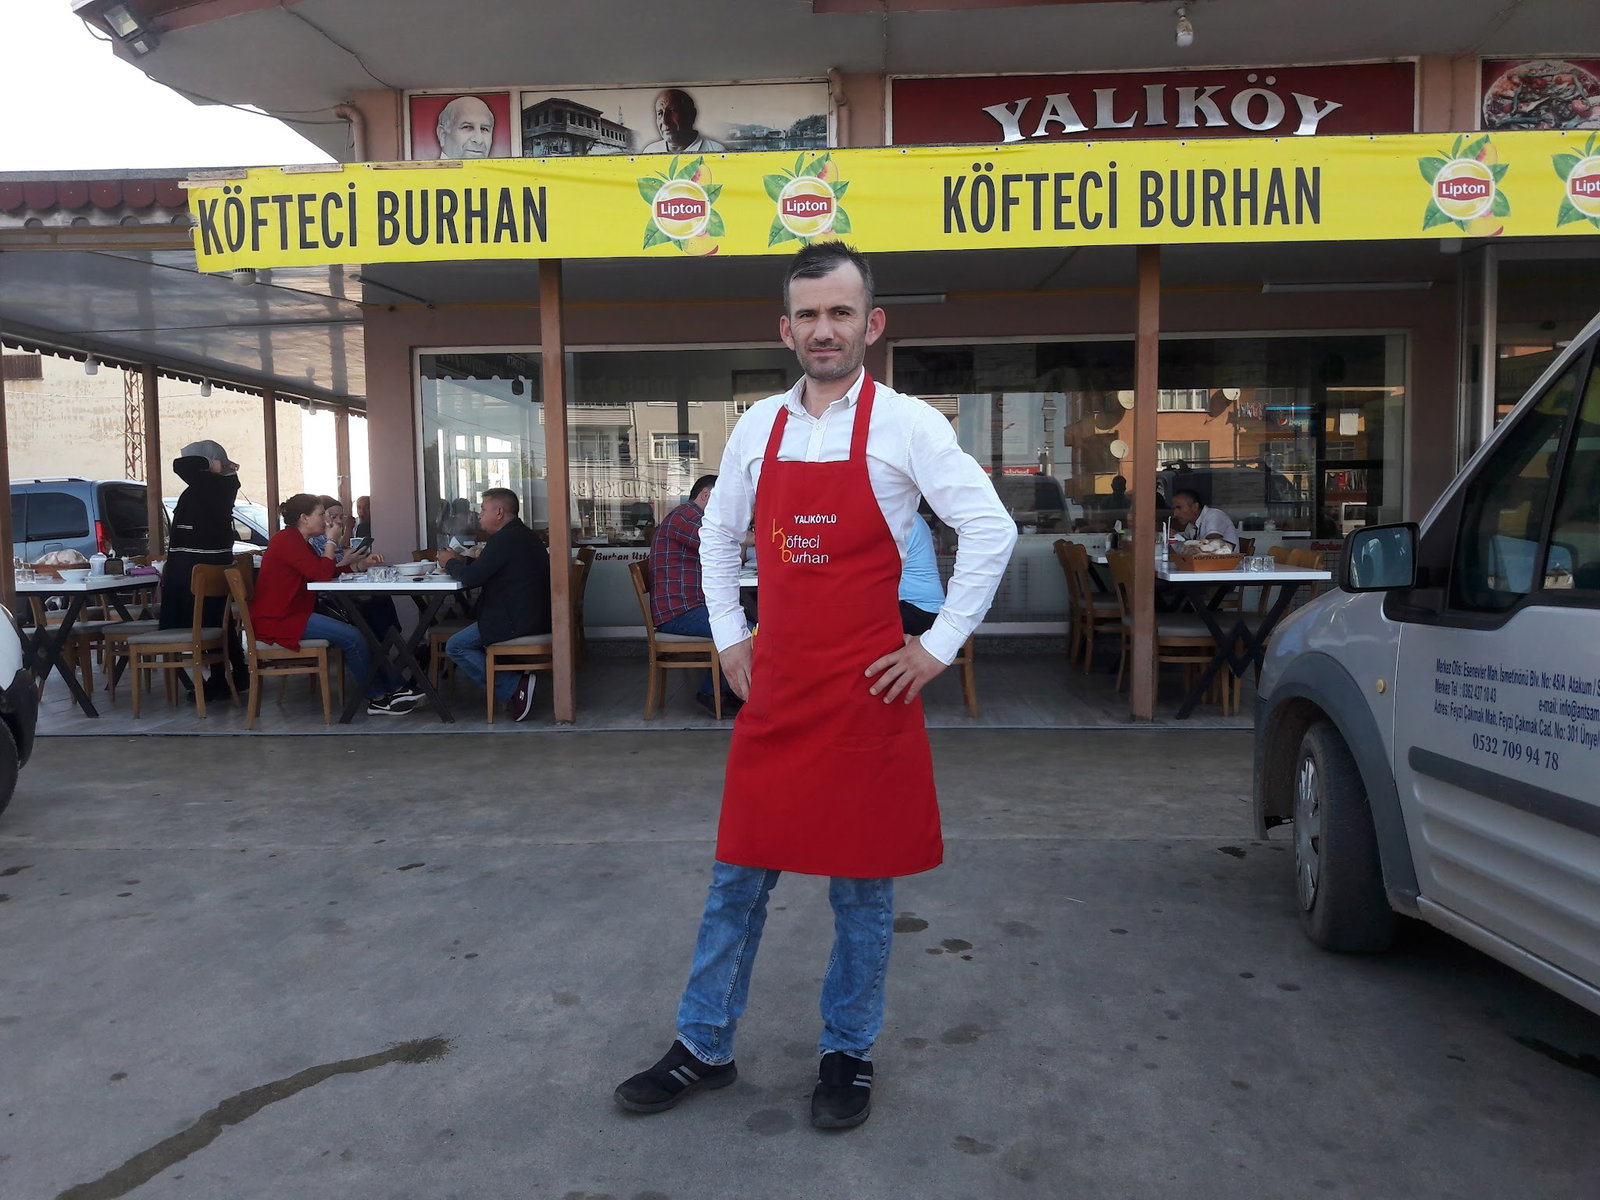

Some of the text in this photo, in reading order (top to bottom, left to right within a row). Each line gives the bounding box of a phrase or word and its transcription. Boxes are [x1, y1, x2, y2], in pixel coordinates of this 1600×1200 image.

[982, 72, 1343, 142] YALIKÖY
[943, 160, 1320, 234] KÖFTECİ BURHAN
[1442, 182, 1486, 197] Lipton
[1575, 179, 1600, 194] Lipt
[198, 181, 547, 255] KÖFTECİ BURHAN
[660, 202, 702, 217] Lipton
[786, 199, 828, 214] Lipton
[794, 513, 837, 524] YALIKÖYLÜ
[1434, 679, 1450, 695] Merkez
[1436, 659, 1452, 674] Merkez
[1540, 672, 1551, 689] No:
[1568, 676, 1592, 696] Atakum
[1538, 697, 1600, 723] e-mail: info@antsam
[1539, 719, 1553, 737] Cad.
[1554, 722, 1565, 740] No:
[1567, 725, 1579, 742] 301
[1472, 733, 1559, 771] 0532 709 94 78
